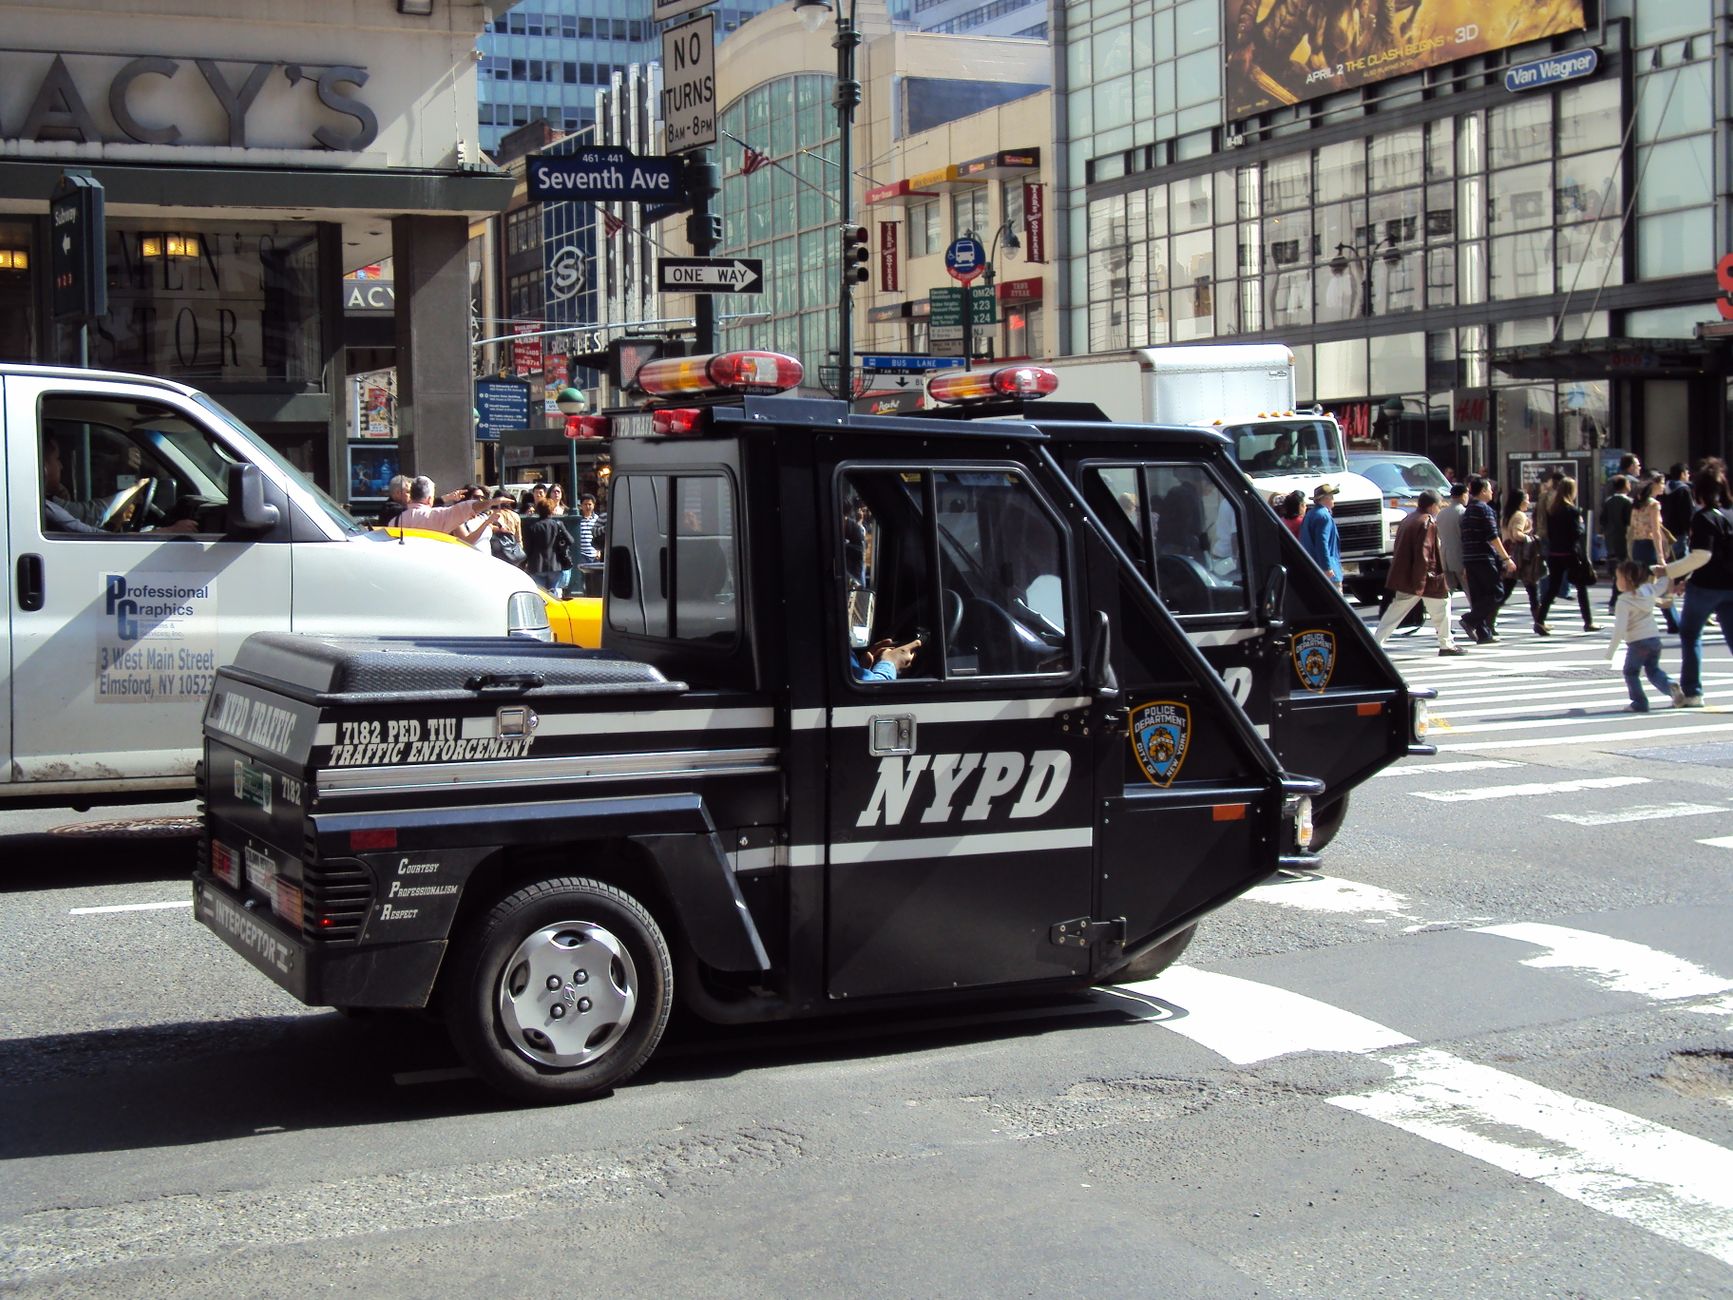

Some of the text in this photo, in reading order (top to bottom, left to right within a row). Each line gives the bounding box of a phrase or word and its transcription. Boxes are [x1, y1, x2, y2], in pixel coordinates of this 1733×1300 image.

[673, 32, 701, 71] NO
[1305, 24, 1479, 84] APRIL 2 THE CLASH BEGINS 3D
[1508, 55, 1593, 85] Van Wagner
[666, 77, 714, 115] TURNS
[582, 154, 599, 163] 461
[607, 154, 624, 163] 441
[537, 166, 670, 190] Seventh Ave
[673, 268, 748, 282] ONE WAY
[891, 359, 937, 367] BUS LANE
[106, 574, 209, 615] Professional
[117, 599, 194, 640] Graphics
[101, 647, 215, 671] 3 West Main Street
[101, 675, 155, 697] Elmsford,
[159, 675, 176, 695] NY
[218, 691, 298, 755] NYPD TRAFFIC
[1134, 714, 1187, 733] DEPARTMENT
[1144, 705, 1176, 718] POLICE
[342, 718, 457, 745] 7182 PED TIU
[328, 736, 535, 766] TRAFFIC ENFORCEMENT
[1136, 742, 1156, 775] CITY OF
[1166, 732, 1188, 777] NEW YORK
[281, 775, 302, 806] 7182
[855, 749, 1072, 829] NYPD
[215, 899, 276, 964] INTERCEPTOR
